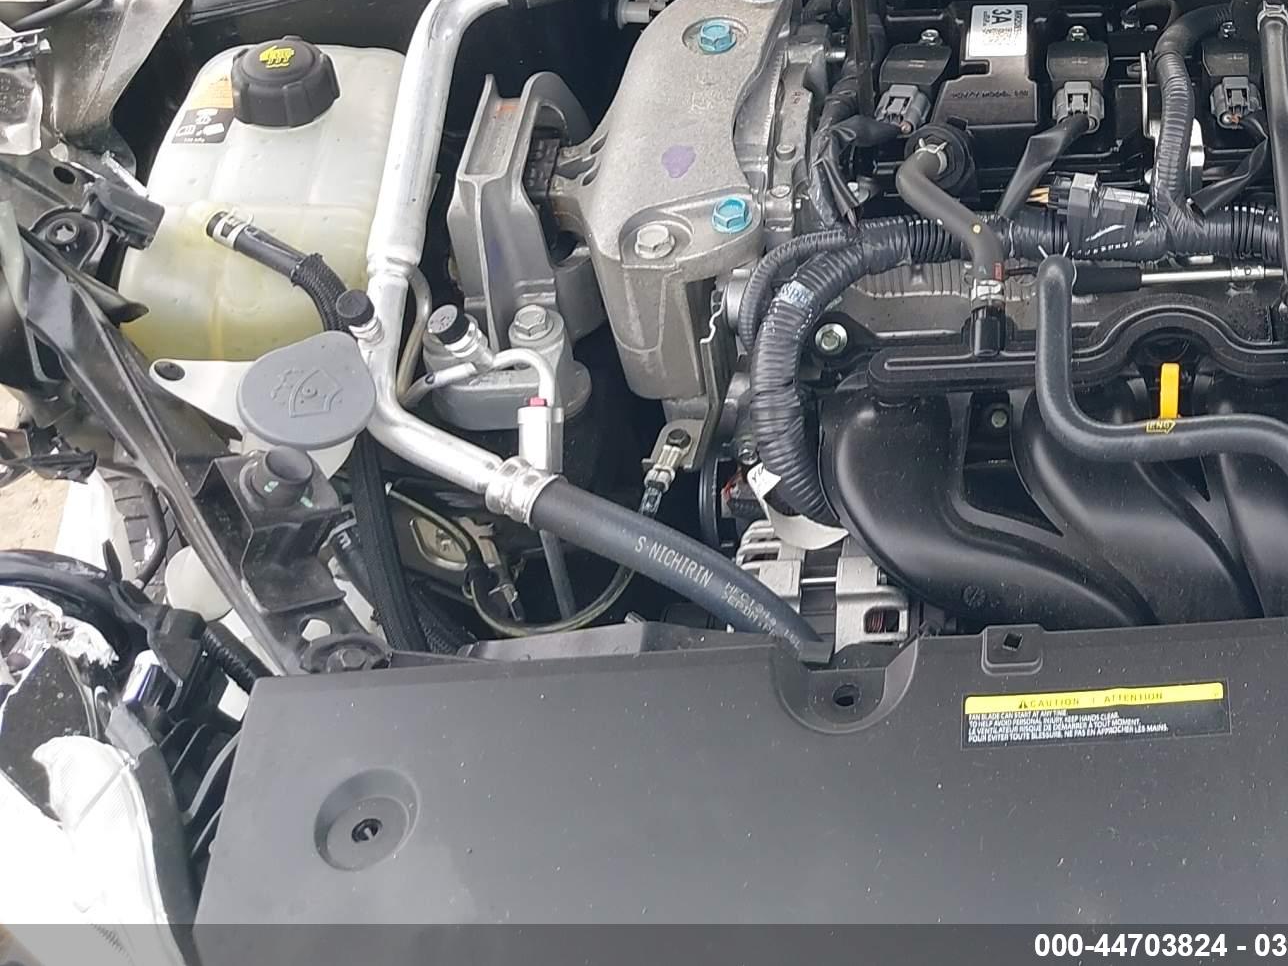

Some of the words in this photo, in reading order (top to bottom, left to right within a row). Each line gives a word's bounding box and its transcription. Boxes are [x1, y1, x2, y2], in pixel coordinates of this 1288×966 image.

[992, 9, 1012, 25] 3A
[1029, 696, 1079, 708] CAUTION
[1104, 692, 1163, 704] ATTENTION
[1012, 718, 1042, 726] PERSONAL
[976, 725, 1019, 734] VENTILATEUR
[1096, 725, 1134, 735] APPROCHER
